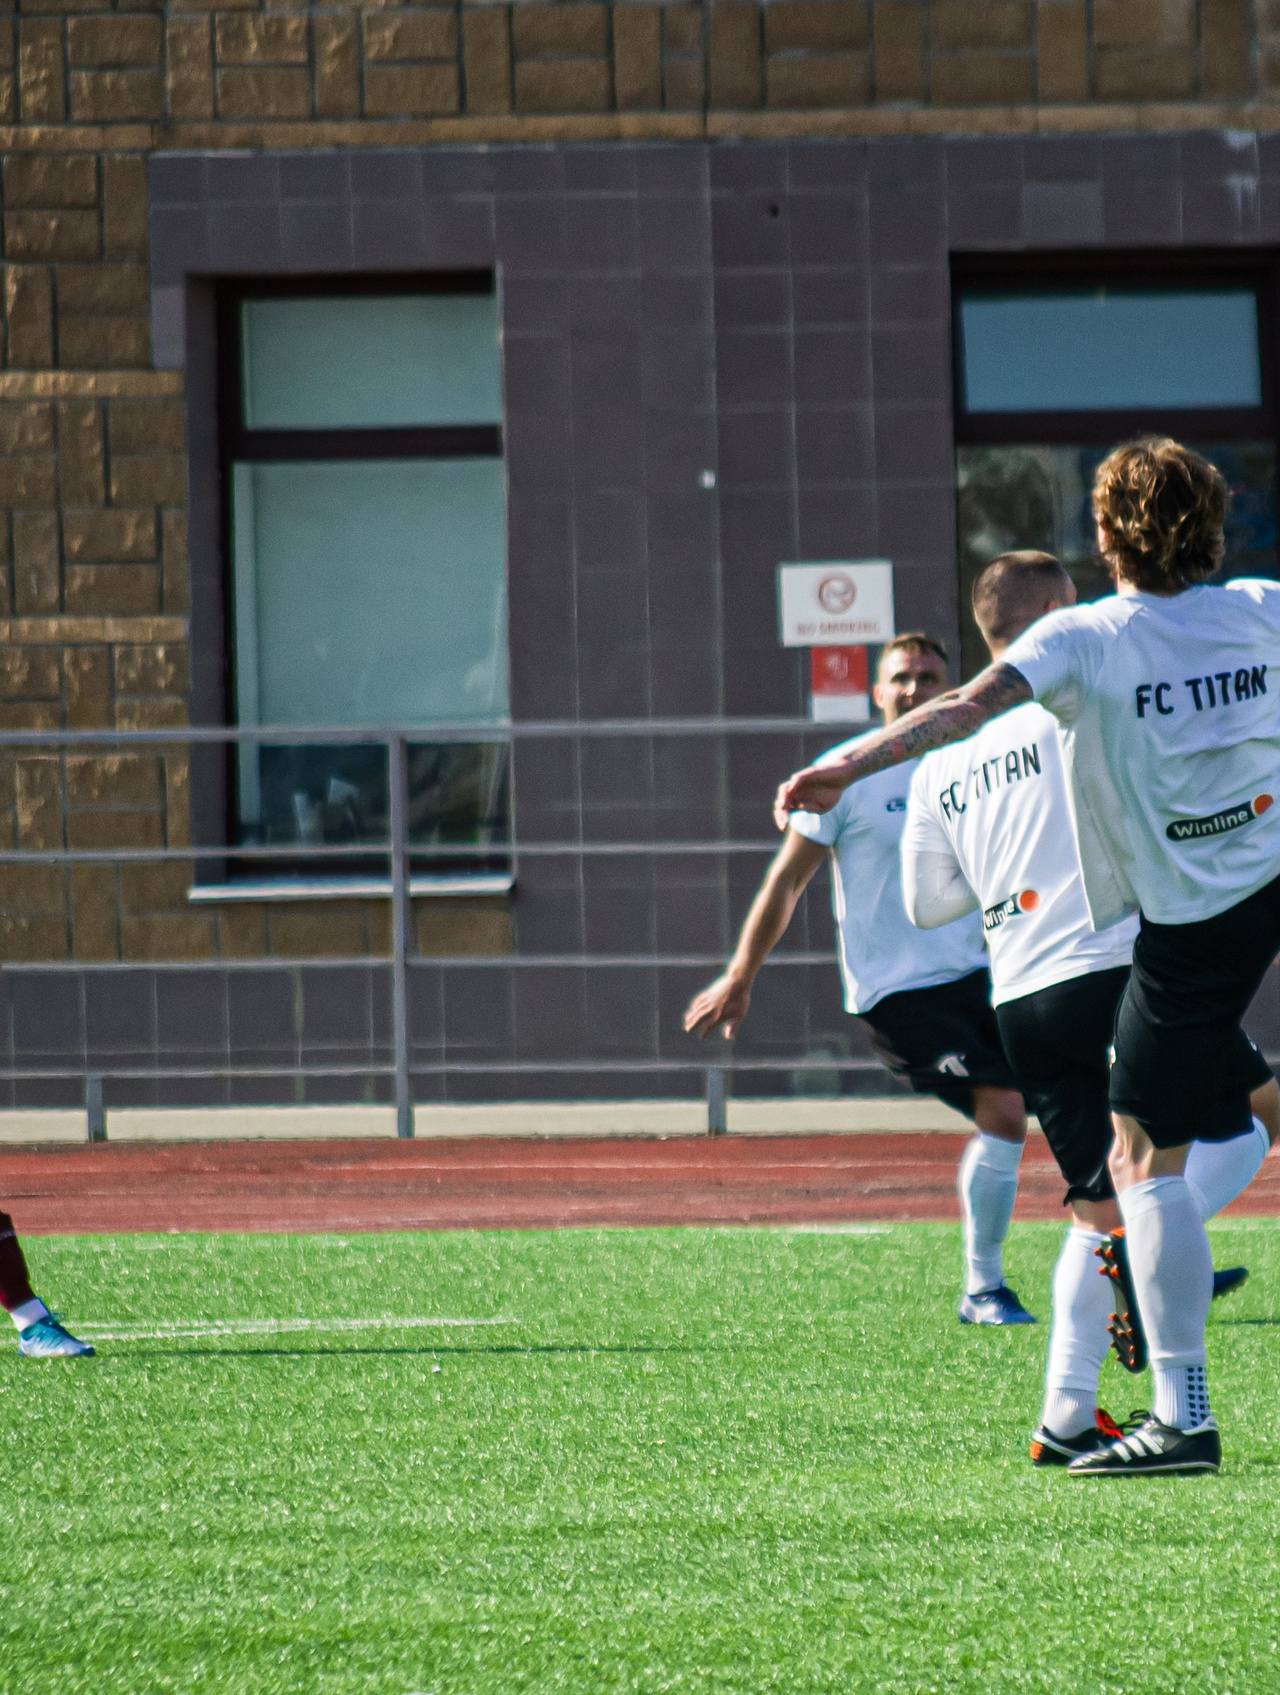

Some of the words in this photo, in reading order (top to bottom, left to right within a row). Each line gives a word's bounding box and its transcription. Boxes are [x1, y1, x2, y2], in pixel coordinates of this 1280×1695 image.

[1135, 681, 1175, 719] FC
[1184, 664, 1268, 712] TITAN
[939, 780, 966, 822] FC
[972, 742, 1041, 800] TITAN
[1173, 807, 1249, 838] Winline
